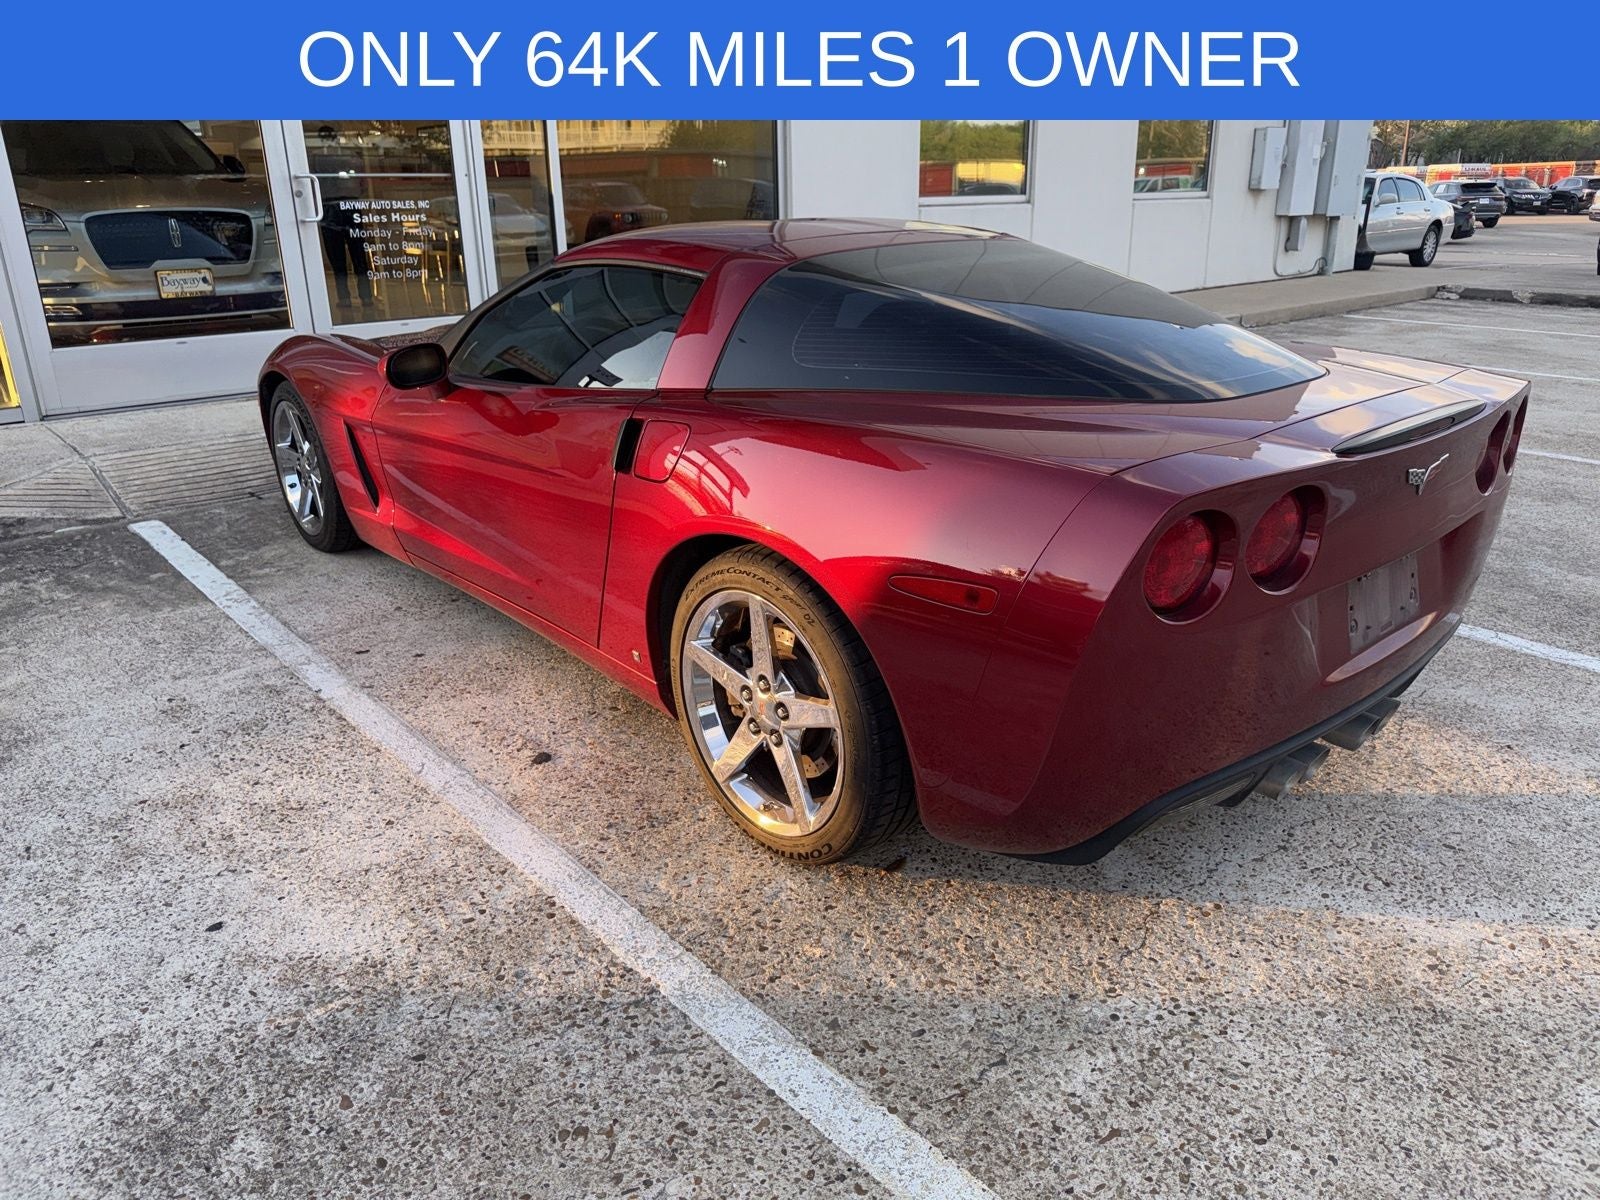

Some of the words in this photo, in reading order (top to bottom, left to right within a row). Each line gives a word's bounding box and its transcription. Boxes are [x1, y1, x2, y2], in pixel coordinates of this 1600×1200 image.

[340, 201, 370, 210] BAYWAY
[371, 201, 391, 210] AUTO
[393, 200, 417, 210] SALES,
[418, 200, 430, 209] INC
[353, 213, 387, 223] Sales
[391, 212, 427, 222] Hours
[350, 228, 392, 239] Monday
[402, 226, 433, 238] Friday
[363, 242, 386, 252] 9am
[389, 242, 399, 251] to
[373, 255, 419, 266] Saturday
[367, 270, 390, 280] 9am
[393, 270, 403, 279] to
[405, 269, 428, 280] 8pm
[160, 276, 201, 290] Bayway
